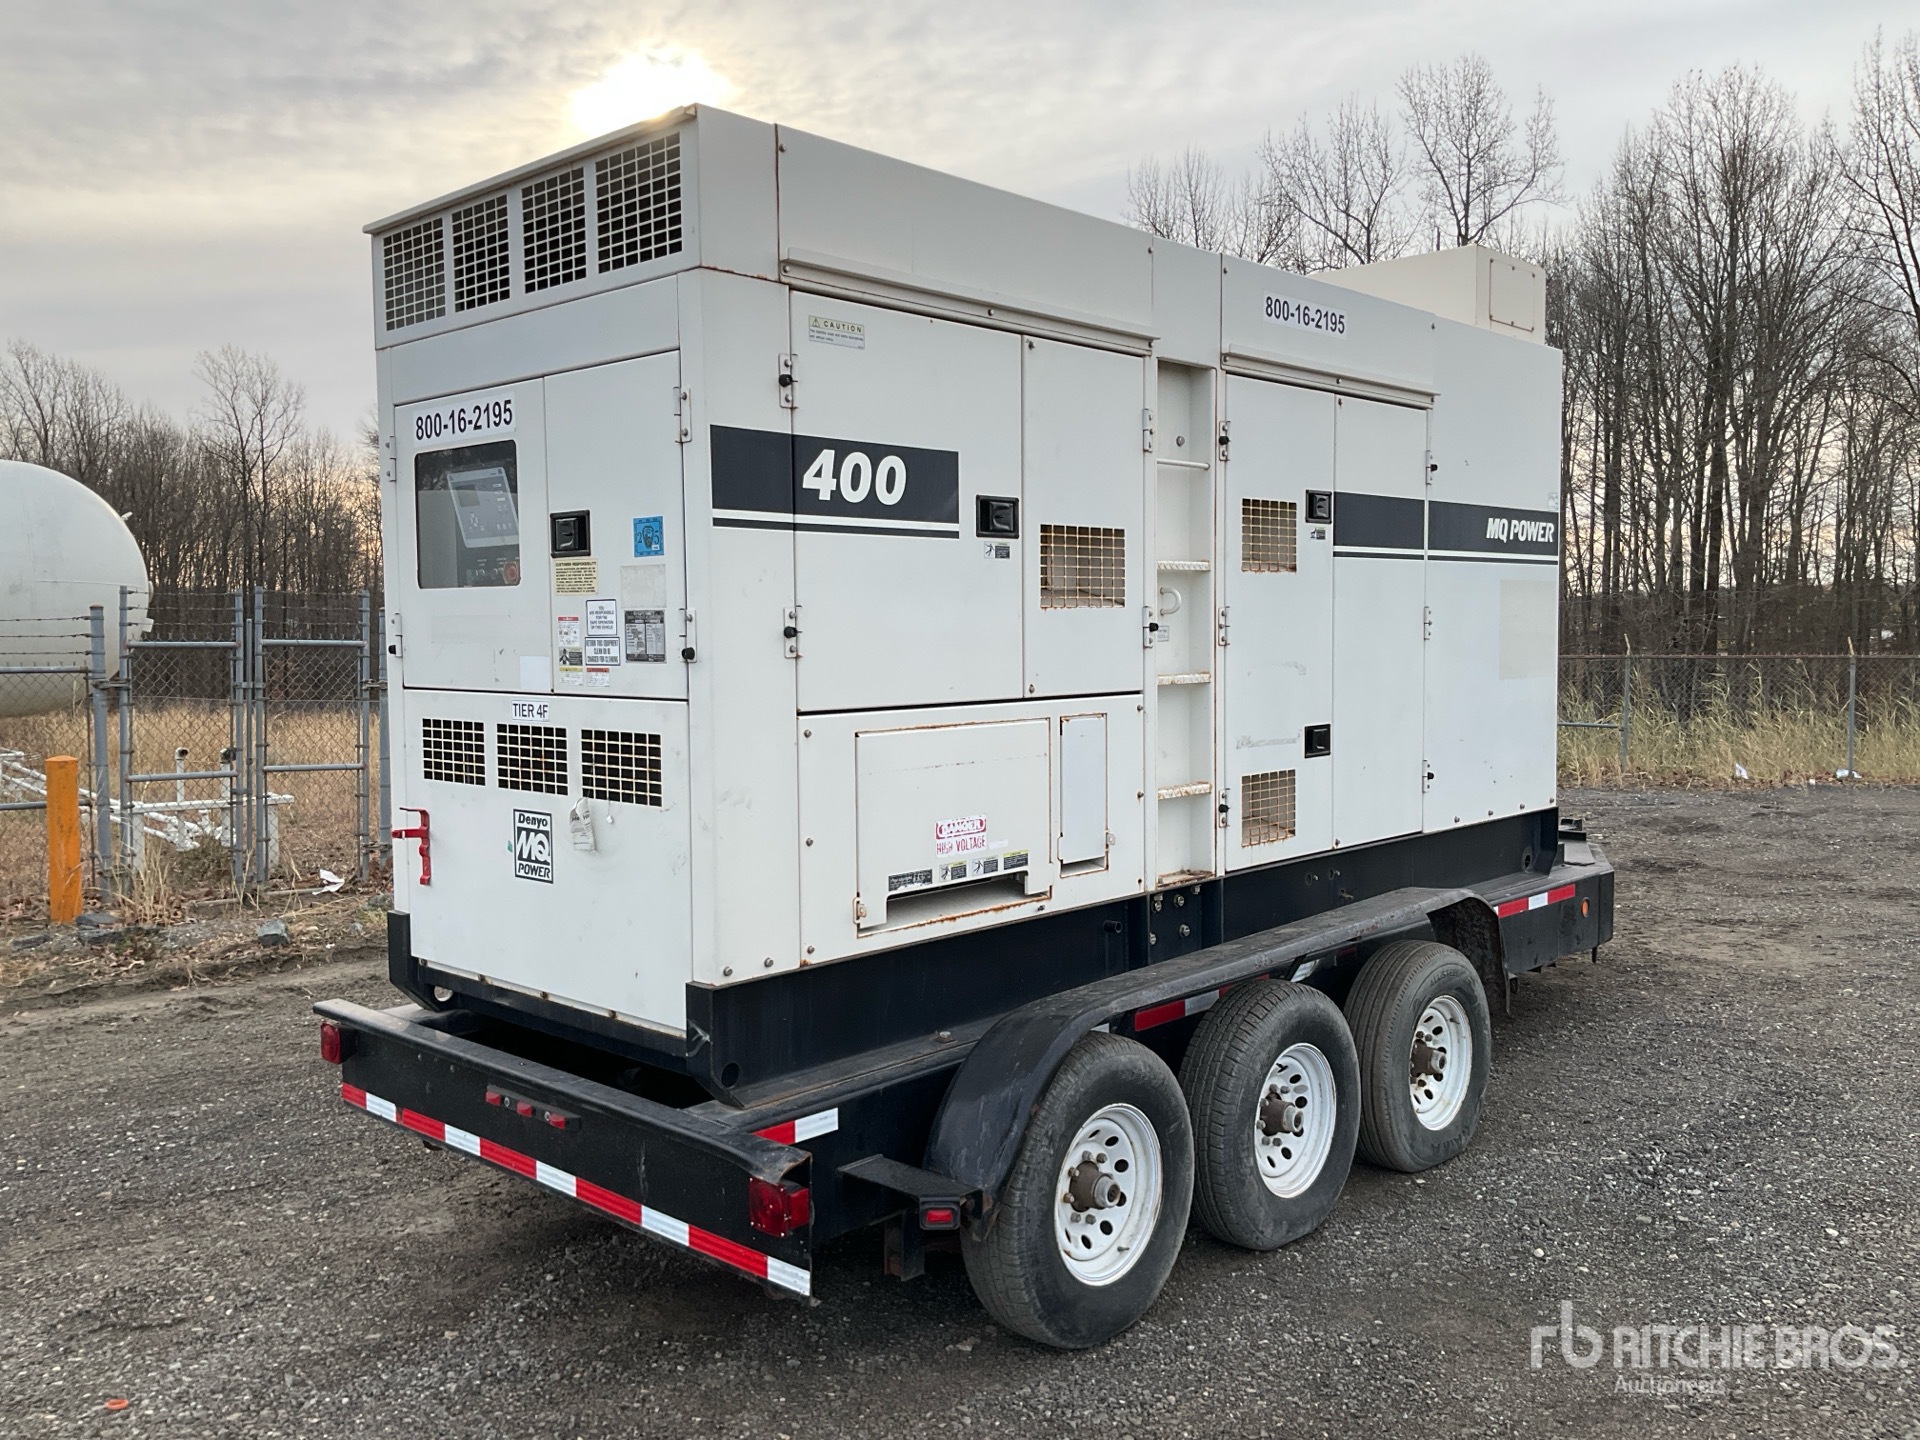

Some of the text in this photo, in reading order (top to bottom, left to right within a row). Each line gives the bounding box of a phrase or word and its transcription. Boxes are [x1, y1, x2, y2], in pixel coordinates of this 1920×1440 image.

[823, 320, 862, 333] CAUTION
[1265, 296, 1345, 334] 800-16-2195
[416, 399, 513, 440] 800-16-2195
[802, 449, 907, 506] 400
[1486, 517, 1554, 543] MQ POWER
[512, 703, 549, 719] TIER 4F
[518, 813, 548, 830] Denyo
[517, 830, 551, 864] MQ
[936, 835, 986, 855] HIGH VOLTAGE
[518, 862, 551, 879] POWER
